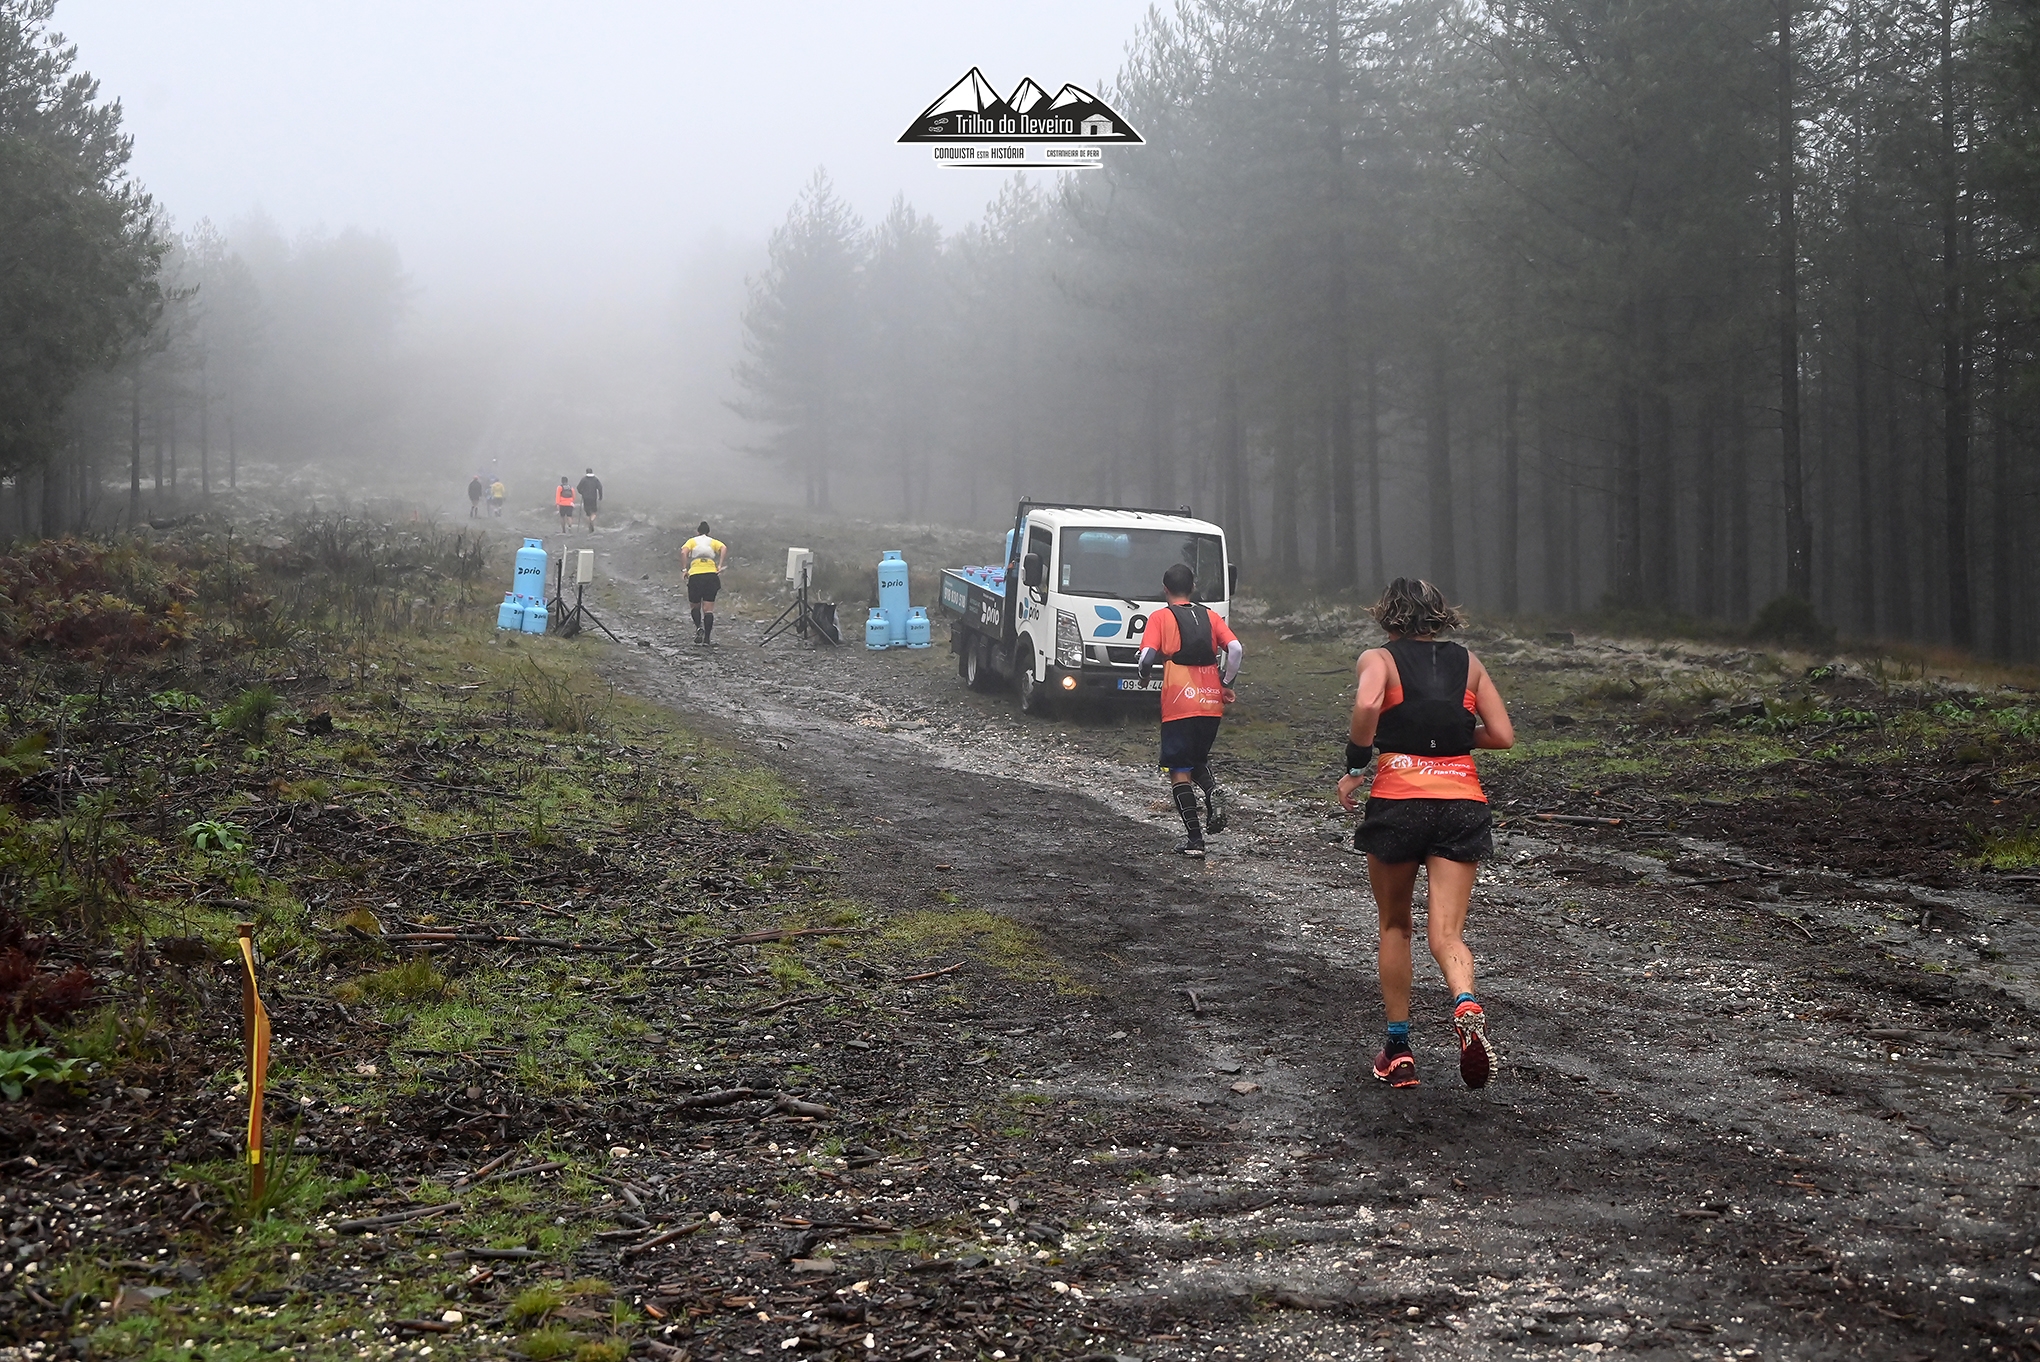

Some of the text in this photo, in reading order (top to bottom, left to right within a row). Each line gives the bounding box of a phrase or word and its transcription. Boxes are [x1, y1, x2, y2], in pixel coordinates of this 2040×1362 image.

[523, 567, 541, 576] prio
[886, 580, 904, 588] prio
[985, 602, 1000, 625] prio
[1029, 604, 1040, 620] prio
